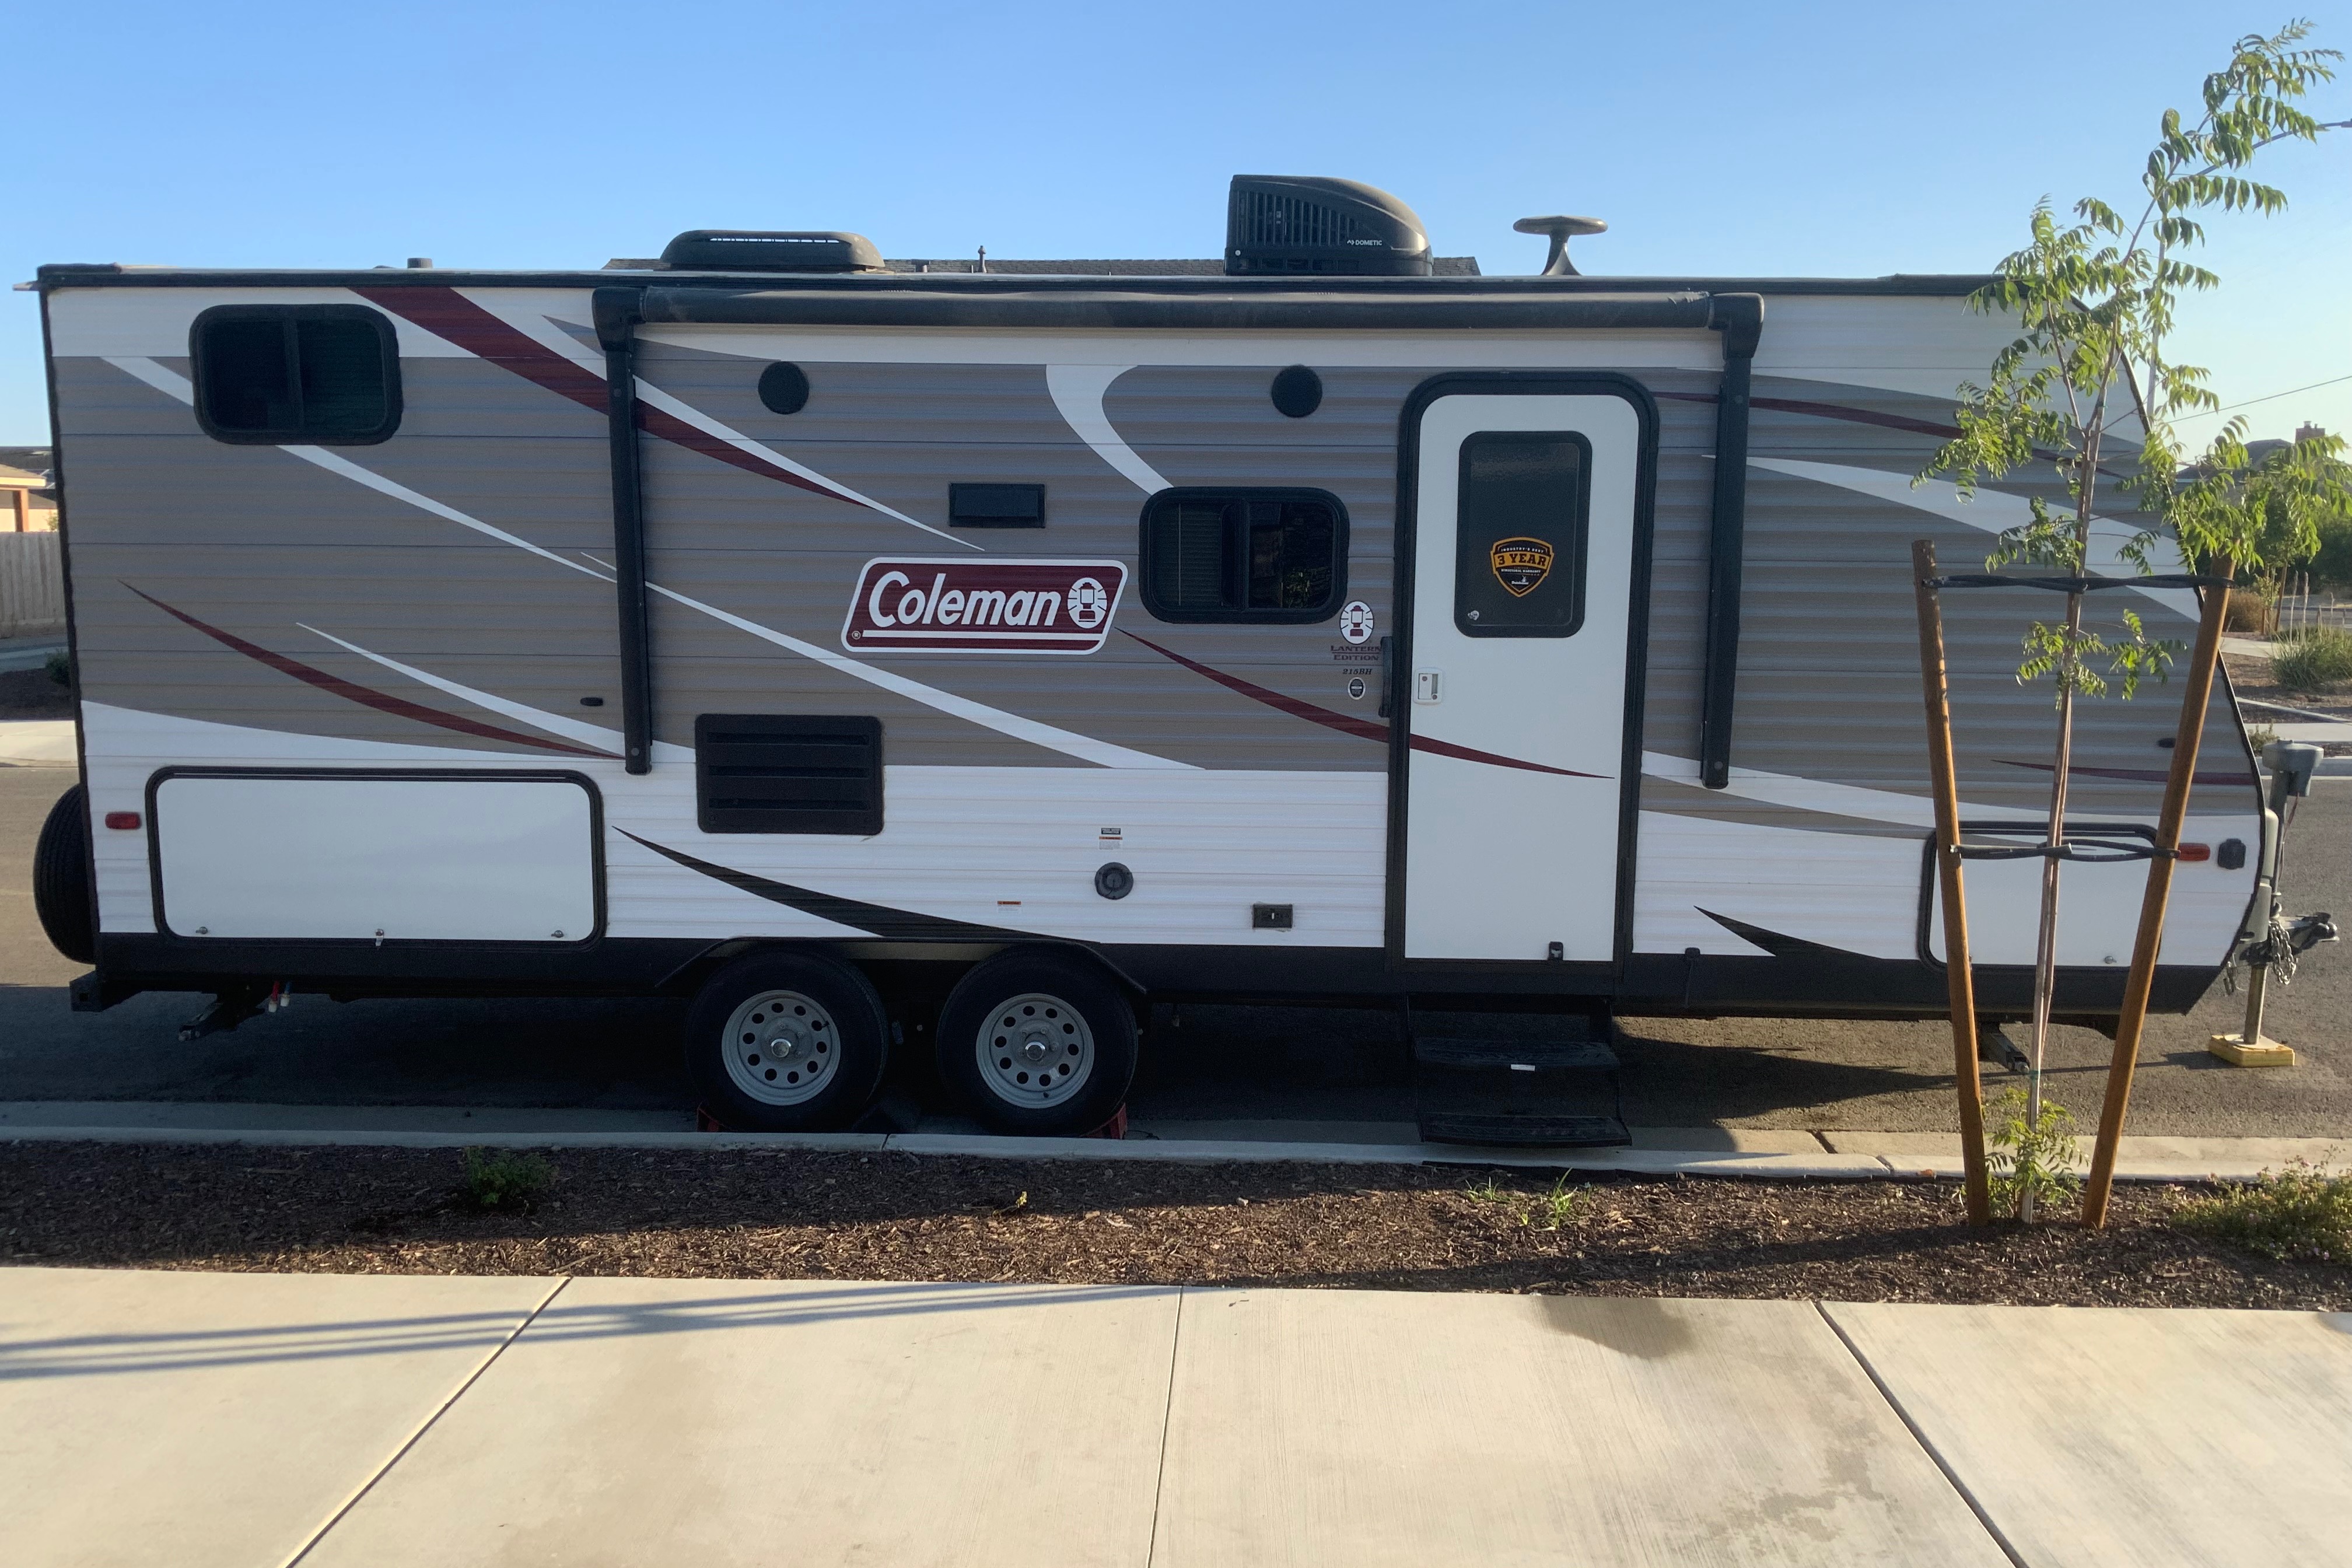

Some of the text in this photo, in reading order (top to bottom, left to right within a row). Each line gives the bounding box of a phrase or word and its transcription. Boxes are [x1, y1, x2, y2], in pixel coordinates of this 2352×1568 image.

[1497, 553, 1546, 567] 3 YEAR
[869, 570, 1061, 628] Coleman
